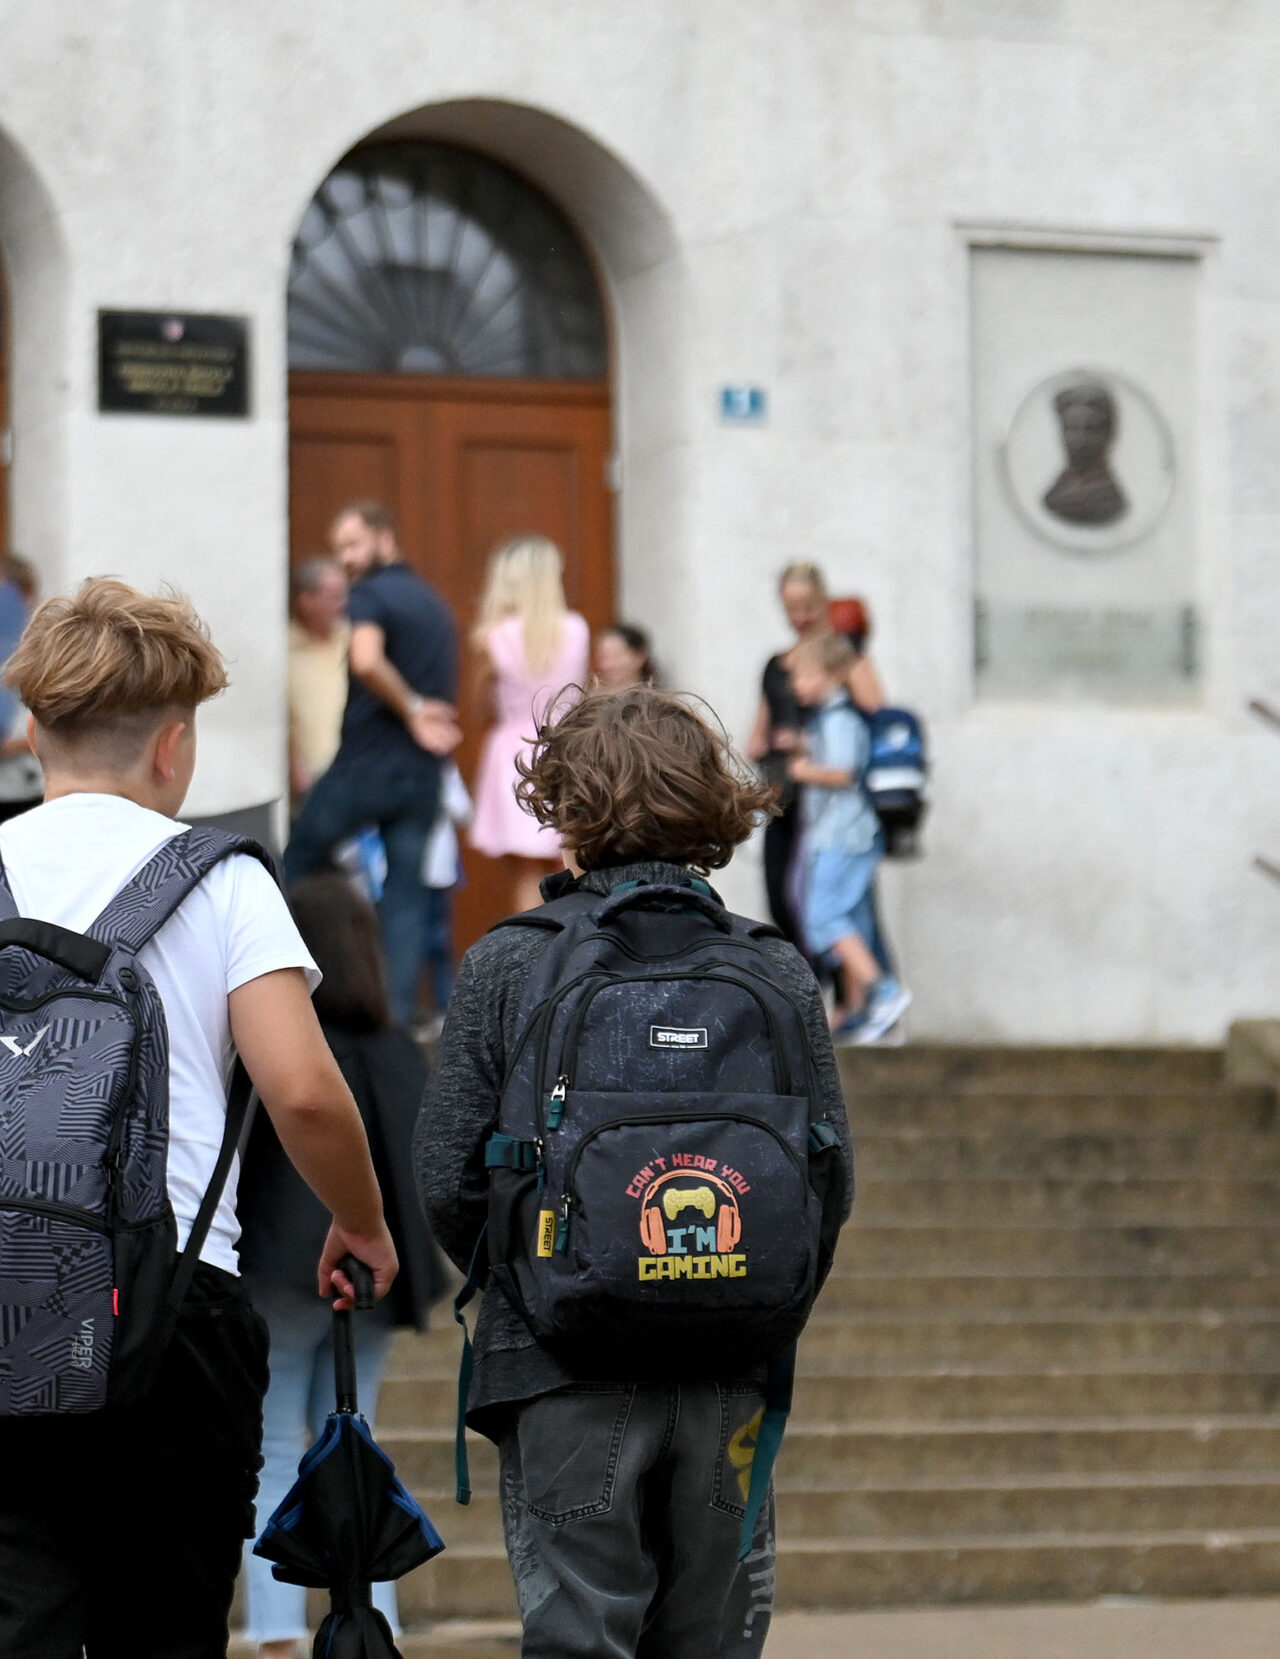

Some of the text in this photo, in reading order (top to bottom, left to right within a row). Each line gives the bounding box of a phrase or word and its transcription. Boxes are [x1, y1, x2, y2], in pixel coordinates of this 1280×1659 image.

[657, 1032, 699, 1043] STREET
[625, 1153, 751, 1198] CAN'T HEAR YOU
[543, 1217, 554, 1250] STREET
[666, 1225, 717, 1254] I'M
[638, 1254, 747, 1281] GAMING
[80, 1317, 95, 1369] VIPER
